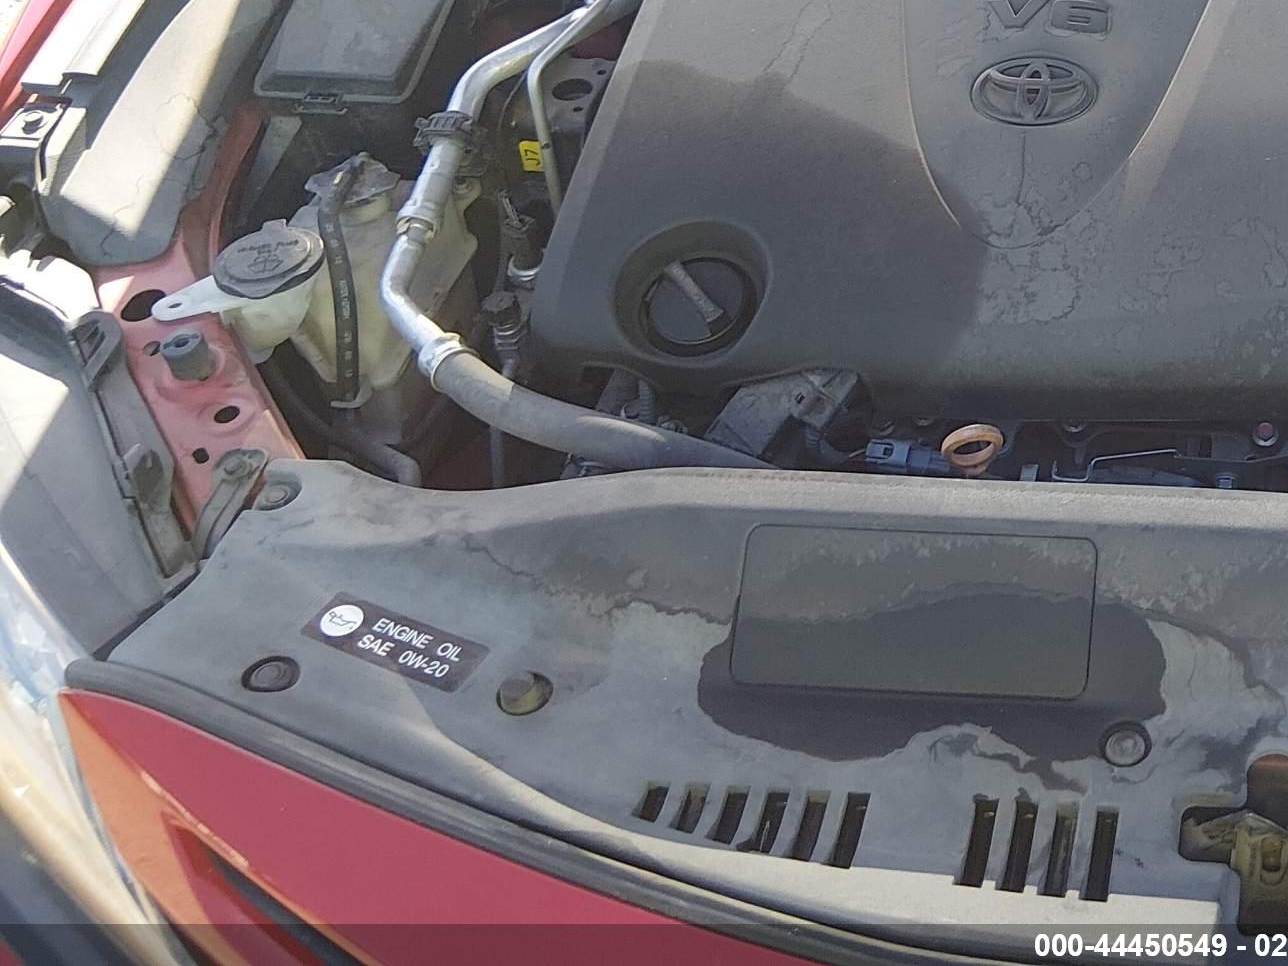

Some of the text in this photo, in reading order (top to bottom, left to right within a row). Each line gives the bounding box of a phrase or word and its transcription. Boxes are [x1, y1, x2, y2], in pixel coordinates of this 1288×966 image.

[357, 634, 450, 678] SAE 0W-20
[372, 617, 463, 662] ENGINE OIL
